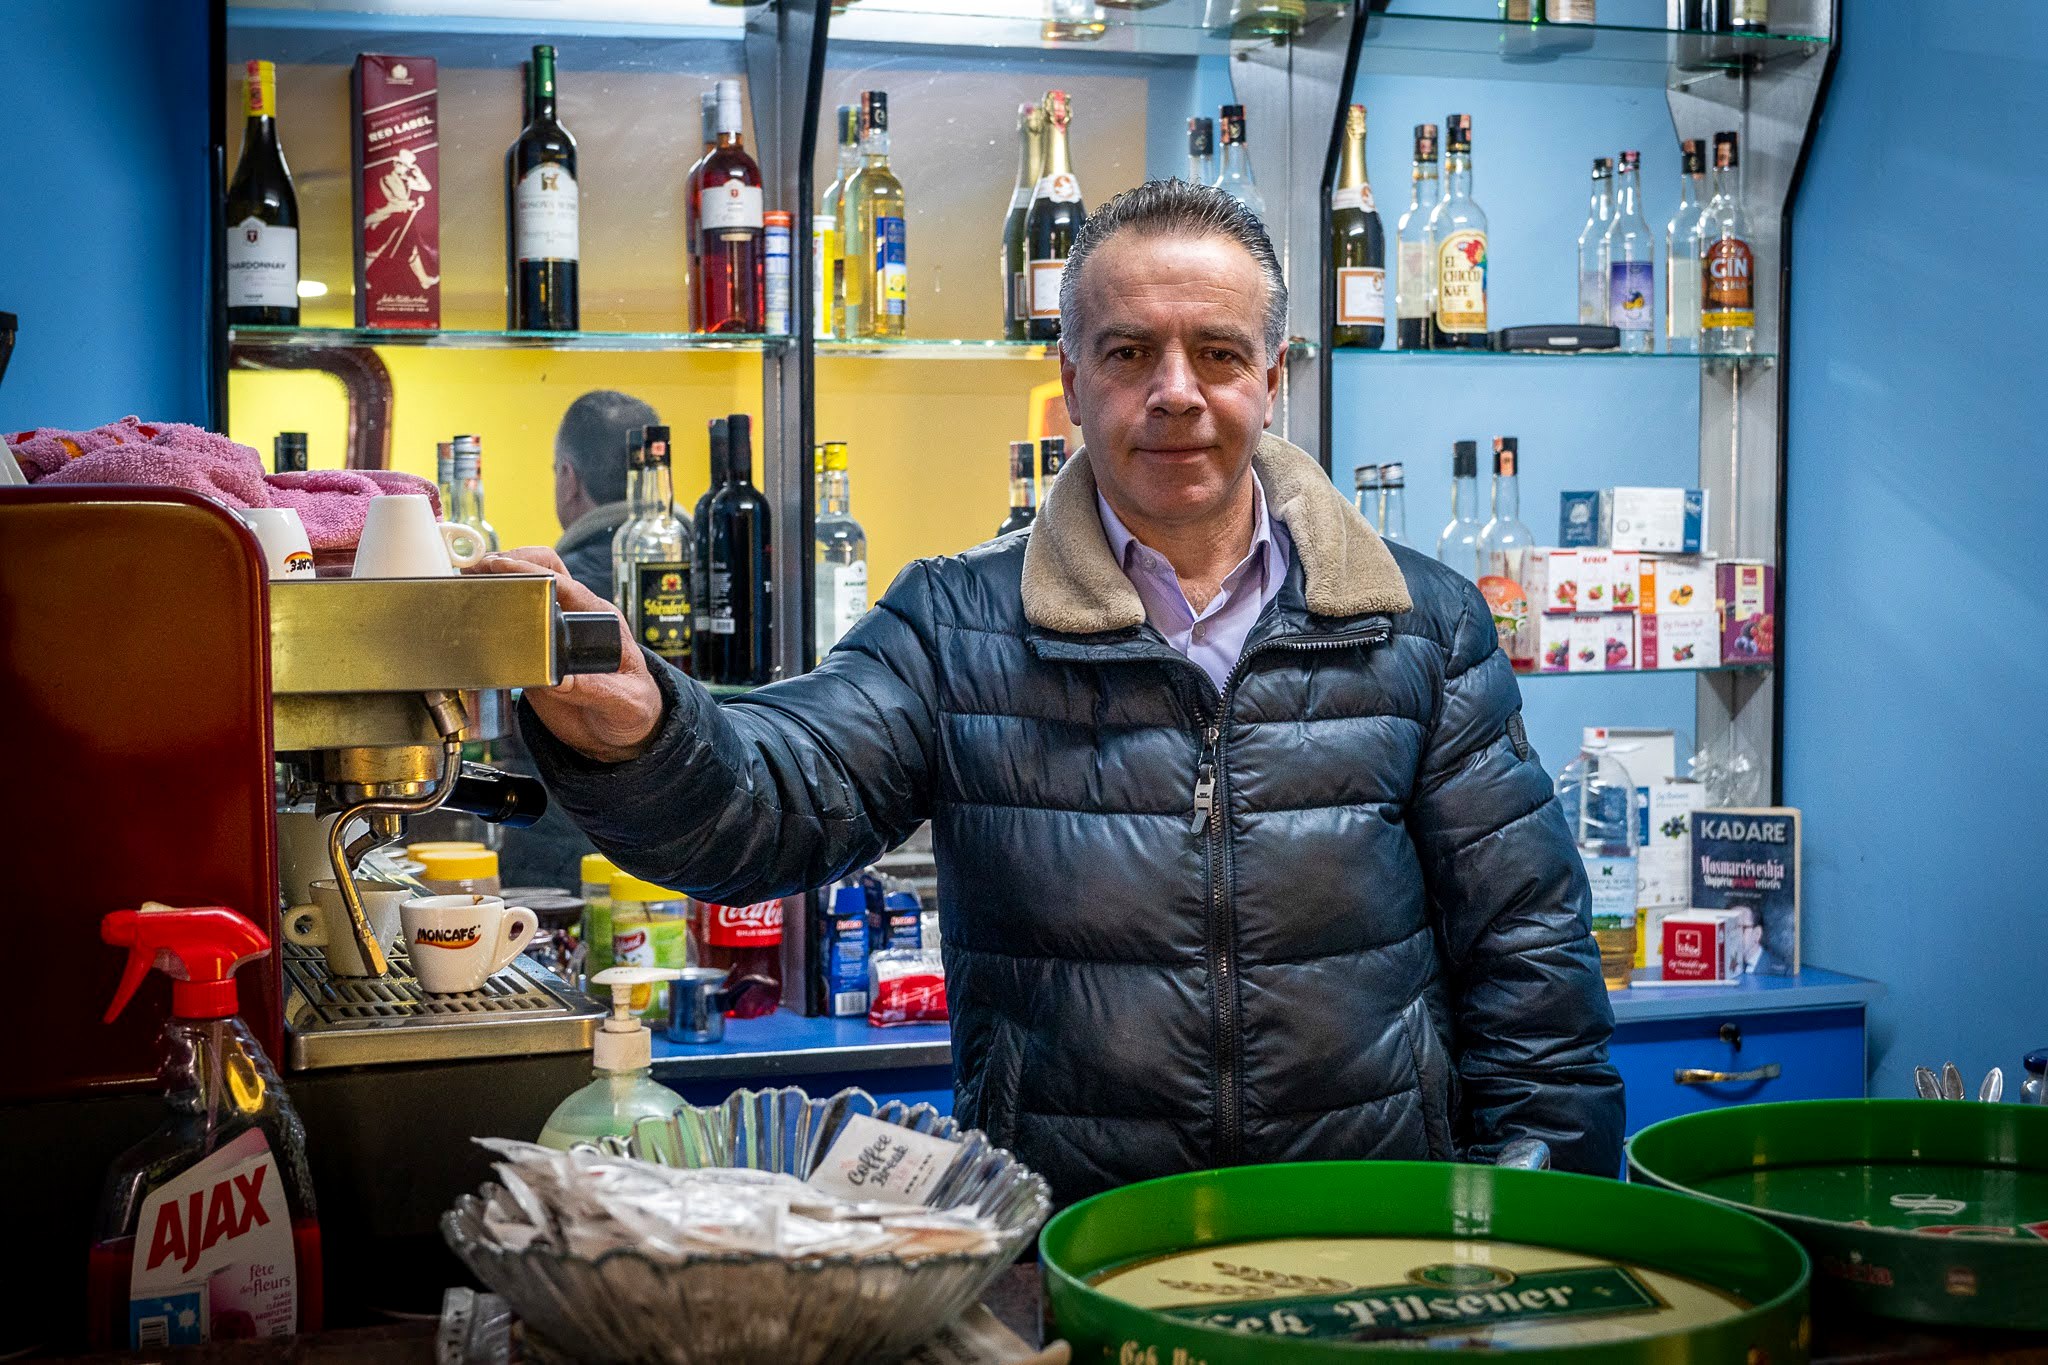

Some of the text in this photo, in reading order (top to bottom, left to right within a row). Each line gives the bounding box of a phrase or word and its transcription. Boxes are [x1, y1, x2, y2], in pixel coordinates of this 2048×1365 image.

[368, 115, 436, 143] RED LABEL
[1710, 257, 1748, 278] GIN
[1700, 819, 1787, 844] KADARE
[145, 1163, 271, 1274] AJAX
[249, 1264, 275, 1282] fête
[253, 1275, 292, 1297] fleurs
[1333, 1285, 1574, 1328] Pilsener
